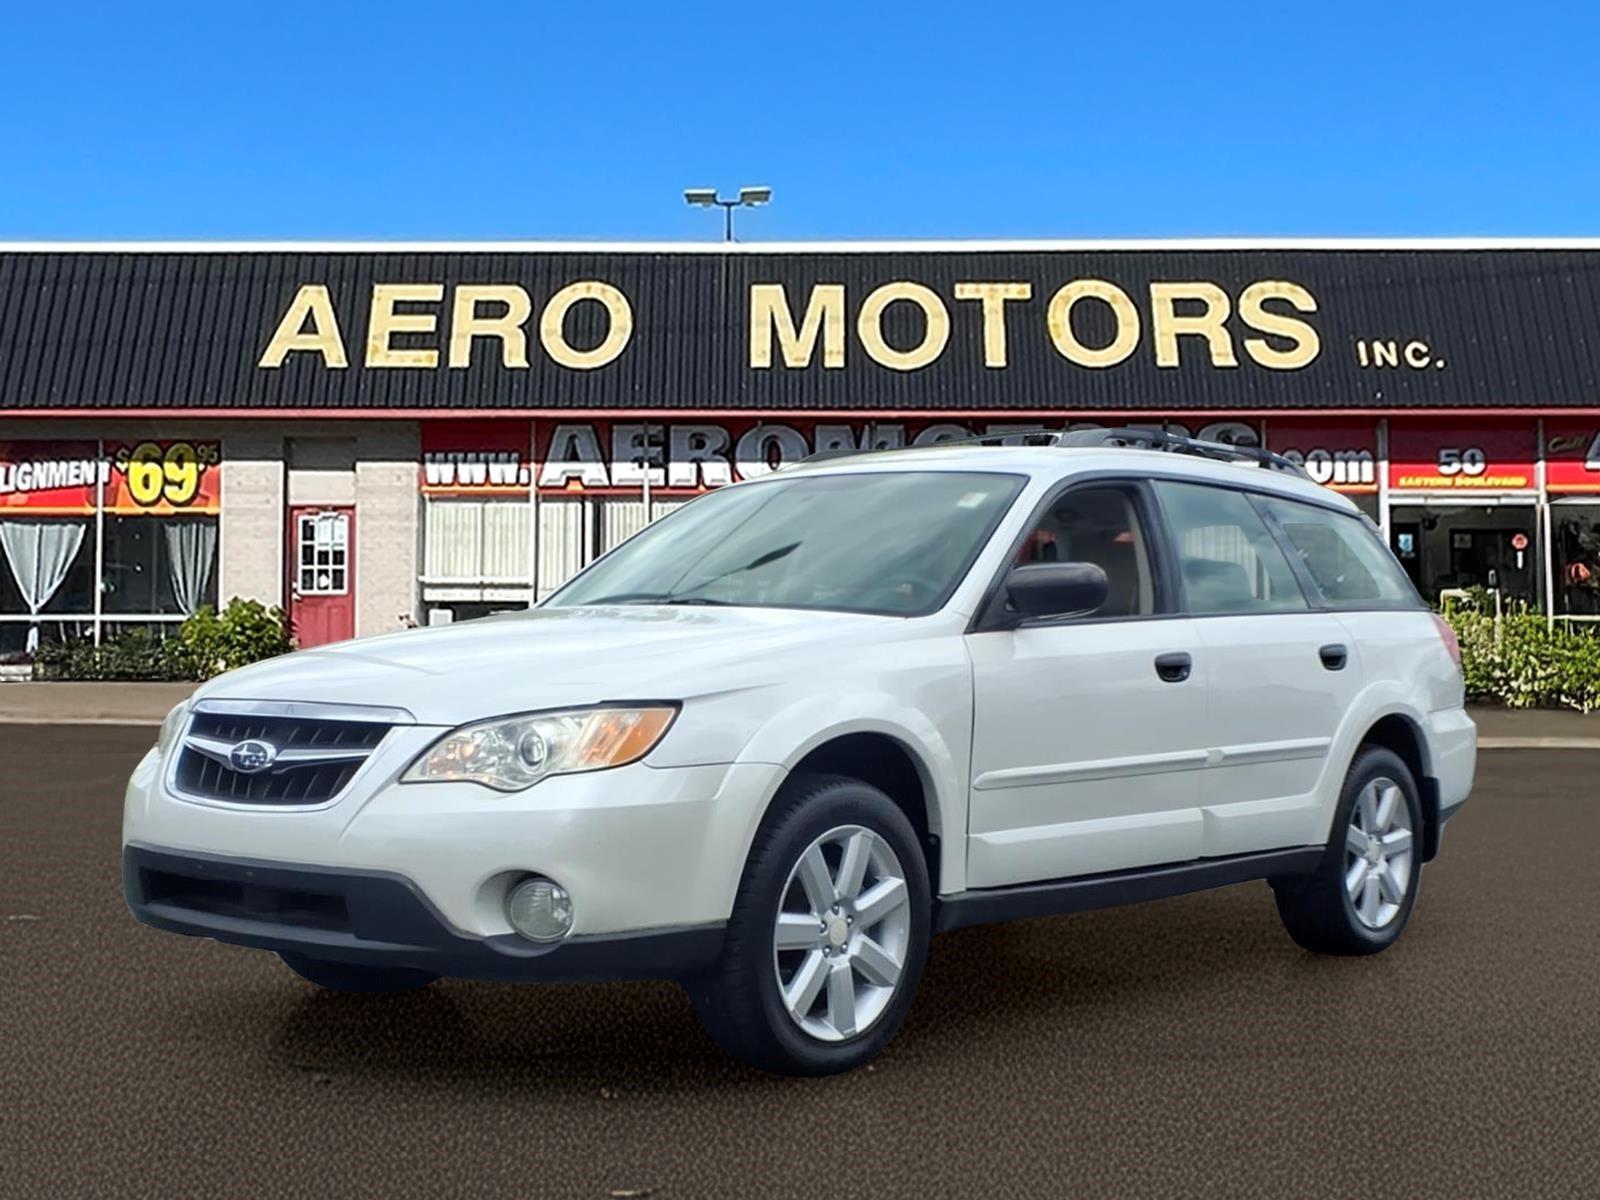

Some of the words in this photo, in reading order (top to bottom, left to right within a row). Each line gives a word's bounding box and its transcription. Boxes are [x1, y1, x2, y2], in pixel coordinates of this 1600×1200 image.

[258, 280, 633, 370] AERO
[749, 278, 1320, 371] MOTORS
[1356, 340, 1446, 369] INC.
[1437, 448, 1485, 476] 50
